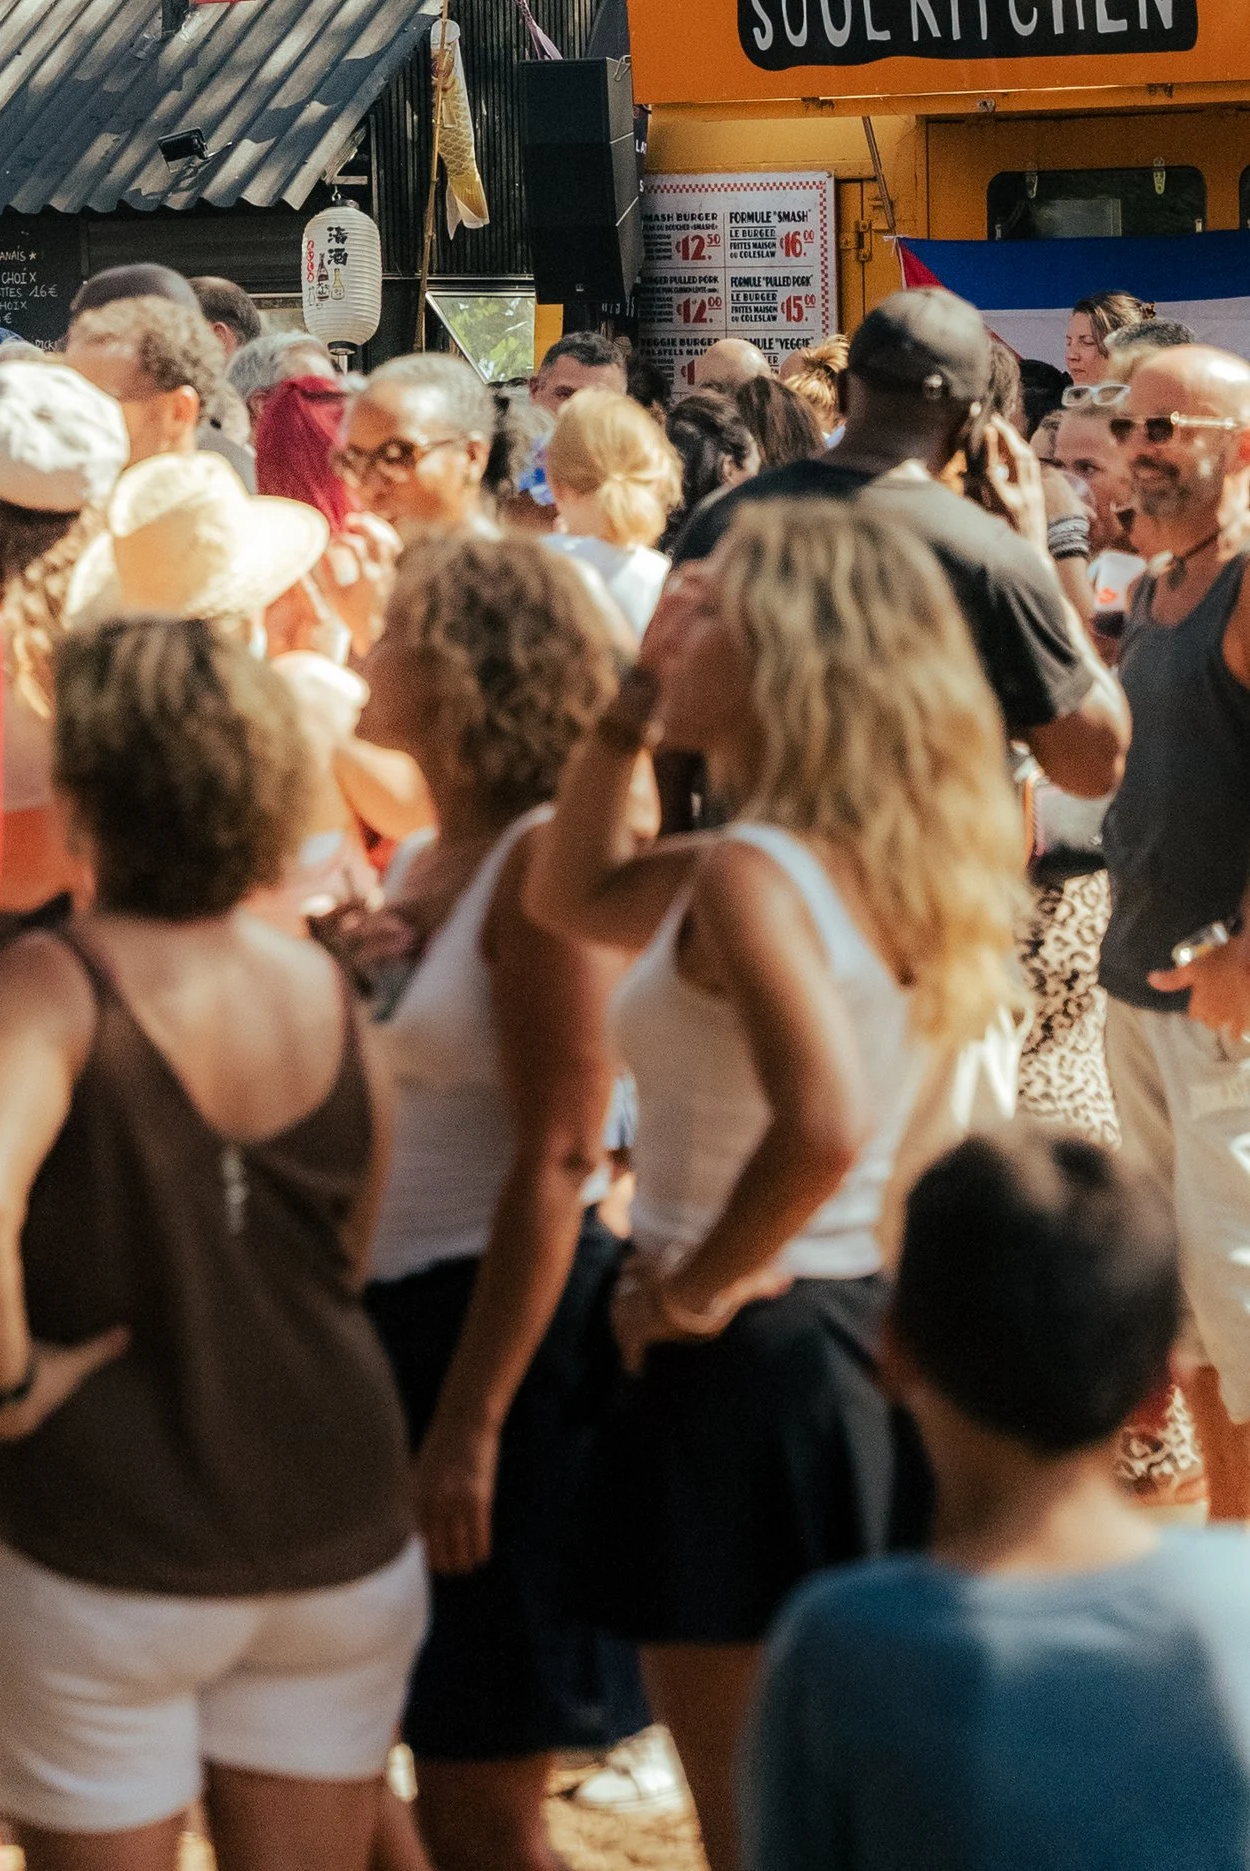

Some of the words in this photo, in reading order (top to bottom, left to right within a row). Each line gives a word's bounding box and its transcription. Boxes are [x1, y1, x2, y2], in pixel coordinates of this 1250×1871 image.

[676, 212, 718, 221] BURGER
[729, 211, 772, 224] FORMULE
[729, 229, 741, 238] LE
[742, 228, 776, 238] BURGER
[729, 242, 751, 250] FRITES
[752, 241, 777, 249] MAISON
[739, 250, 776, 259] COLESLAW
[1, 268, 37, 285] CHOIX
[669, 275, 698, 284] PULLED
[730, 275, 762, 288] FORMULE
[730, 293, 741, 302] LE
[743, 293, 777, 301] BURGER
[730, 305, 752, 314] FRITES
[753, 305, 778, 313] MAISON
[740, 314, 777, 322] COLESLAW
[639, 337, 677, 347] VEGGIE
